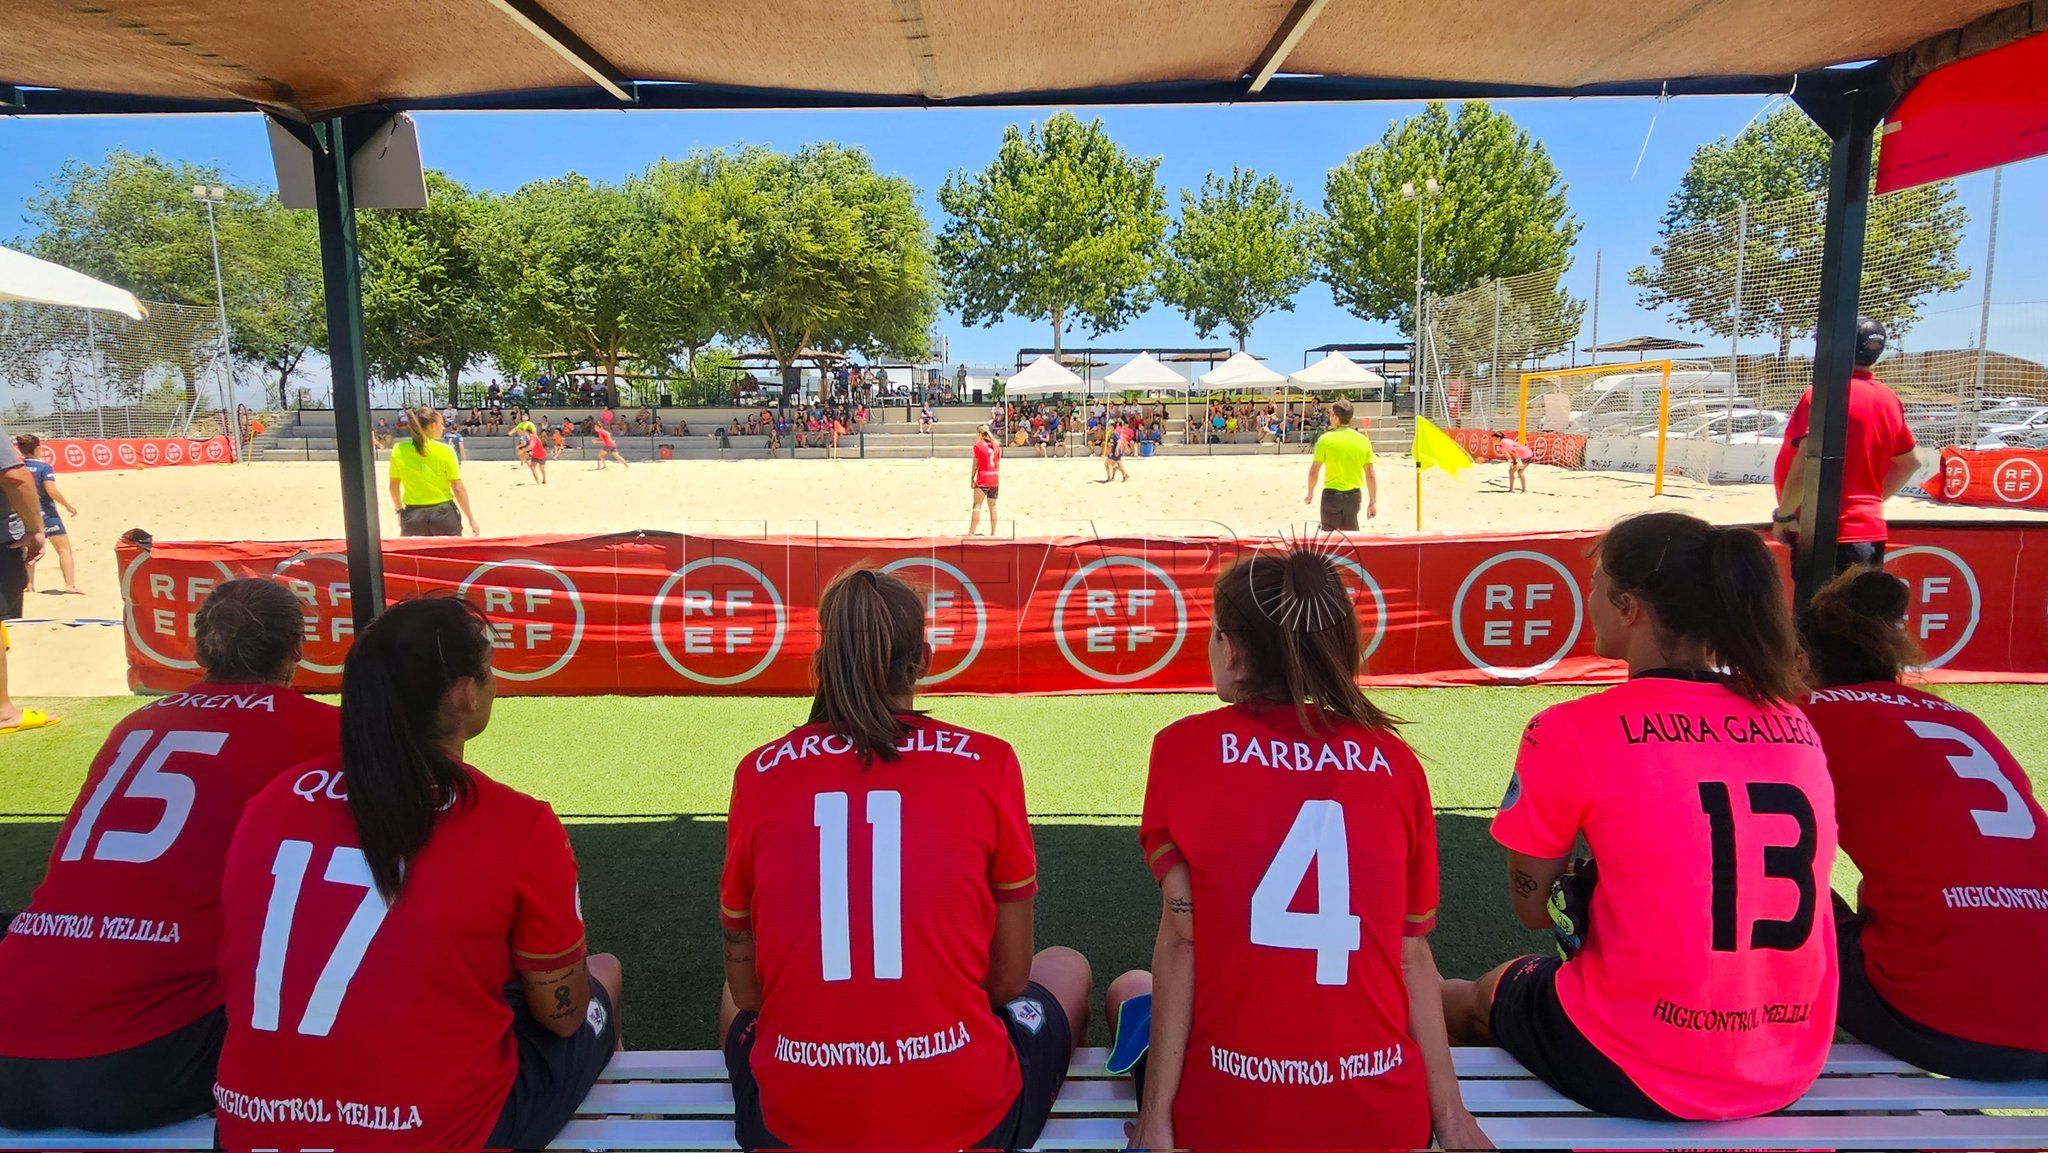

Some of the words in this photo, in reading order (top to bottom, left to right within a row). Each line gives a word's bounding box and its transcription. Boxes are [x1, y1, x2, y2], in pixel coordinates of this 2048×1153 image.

[2004, 482, 2031, 492] EF
[2005, 469, 2032, 479] RF
[484, 587, 553, 613] RF
[684, 590, 754, 616] RF
[1086, 588, 1156, 616] RF
[1485, 583, 1554, 610] RF
[486, 623, 553, 650] EF
[684, 626, 754, 654] EF
[1086, 626, 1156, 652] EF
[1483, 619, 1552, 646] EF
[1619, 713, 1720, 745] LAURA
[1221, 733, 1393, 777] BARBARA
[1903, 719, 2037, 840] 3
[61, 730, 230, 864] 15
[1697, 780, 1818, 953] 13
[813, 790, 903, 983] 11
[1250, 799, 1362, 986] 4
[99, 915, 181, 944] MELILLA
[251, 839, 404, 1037] 17
[1653, 998, 1759, 1032] HIGICONTROL
[774, 1034, 892, 1067] HIGICONTROL
[896, 1020, 970, 1064] MELILLA
[1210, 1045, 1334, 1086] HIGICONTROL
[1339, 1043, 1403, 1081] MELILLA
[212, 1081, 331, 1123] HIGICONTROL
[336, 1099, 424, 1131] MELILLA
